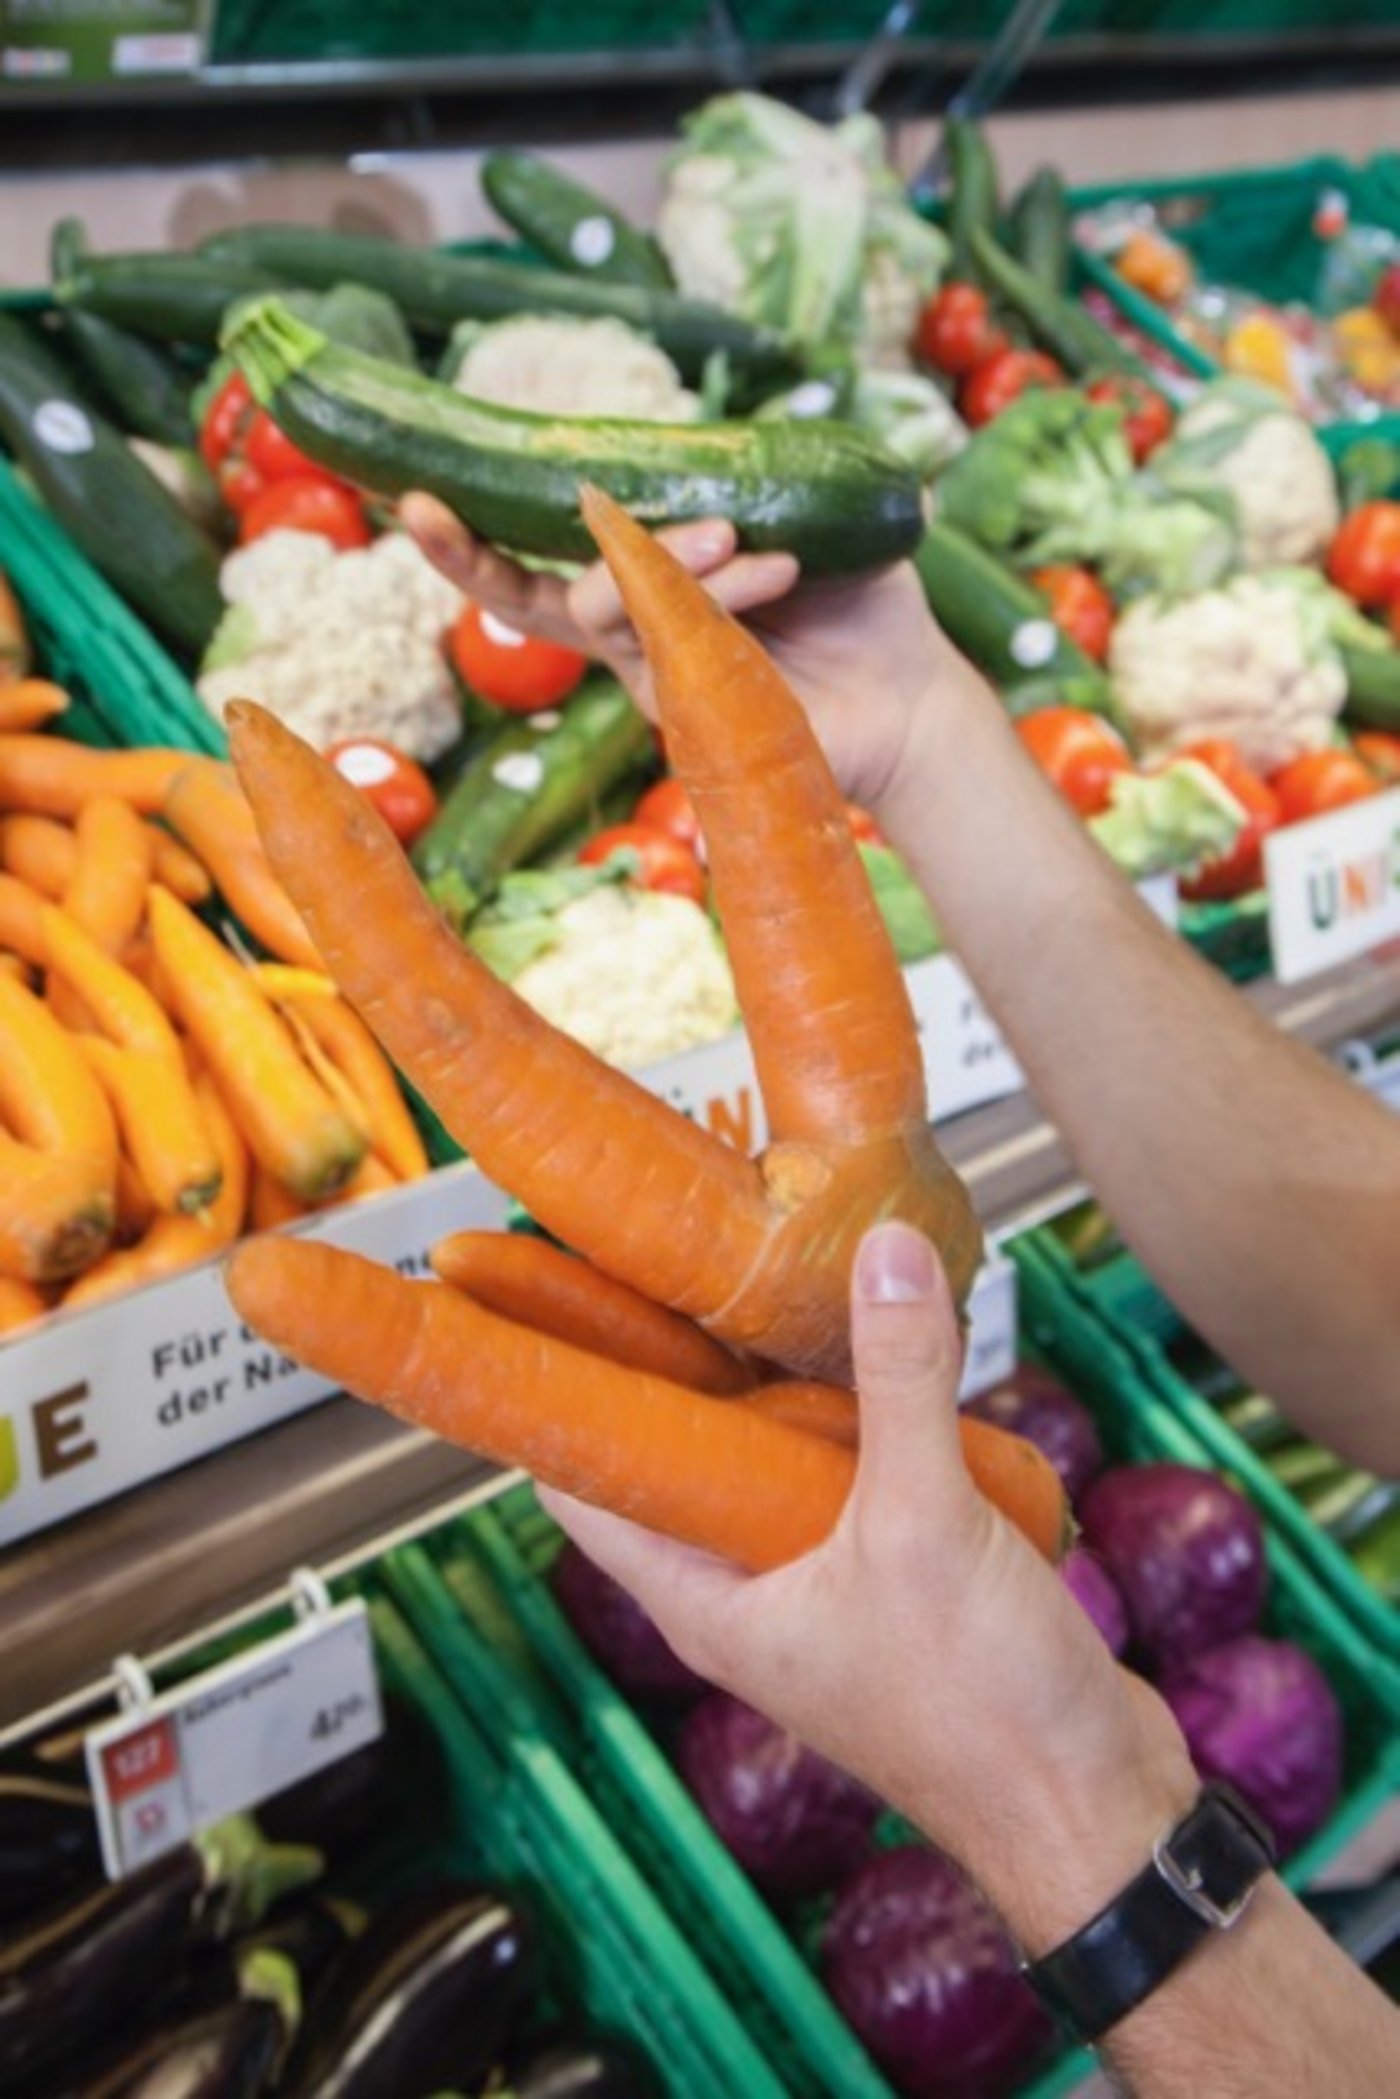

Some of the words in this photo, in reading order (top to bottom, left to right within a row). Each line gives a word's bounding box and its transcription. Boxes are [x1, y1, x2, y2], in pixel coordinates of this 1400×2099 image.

[152, 1326, 227, 1380] Für
[157, 1377, 231, 1427] der
[244, 1352, 301, 1392] Na
